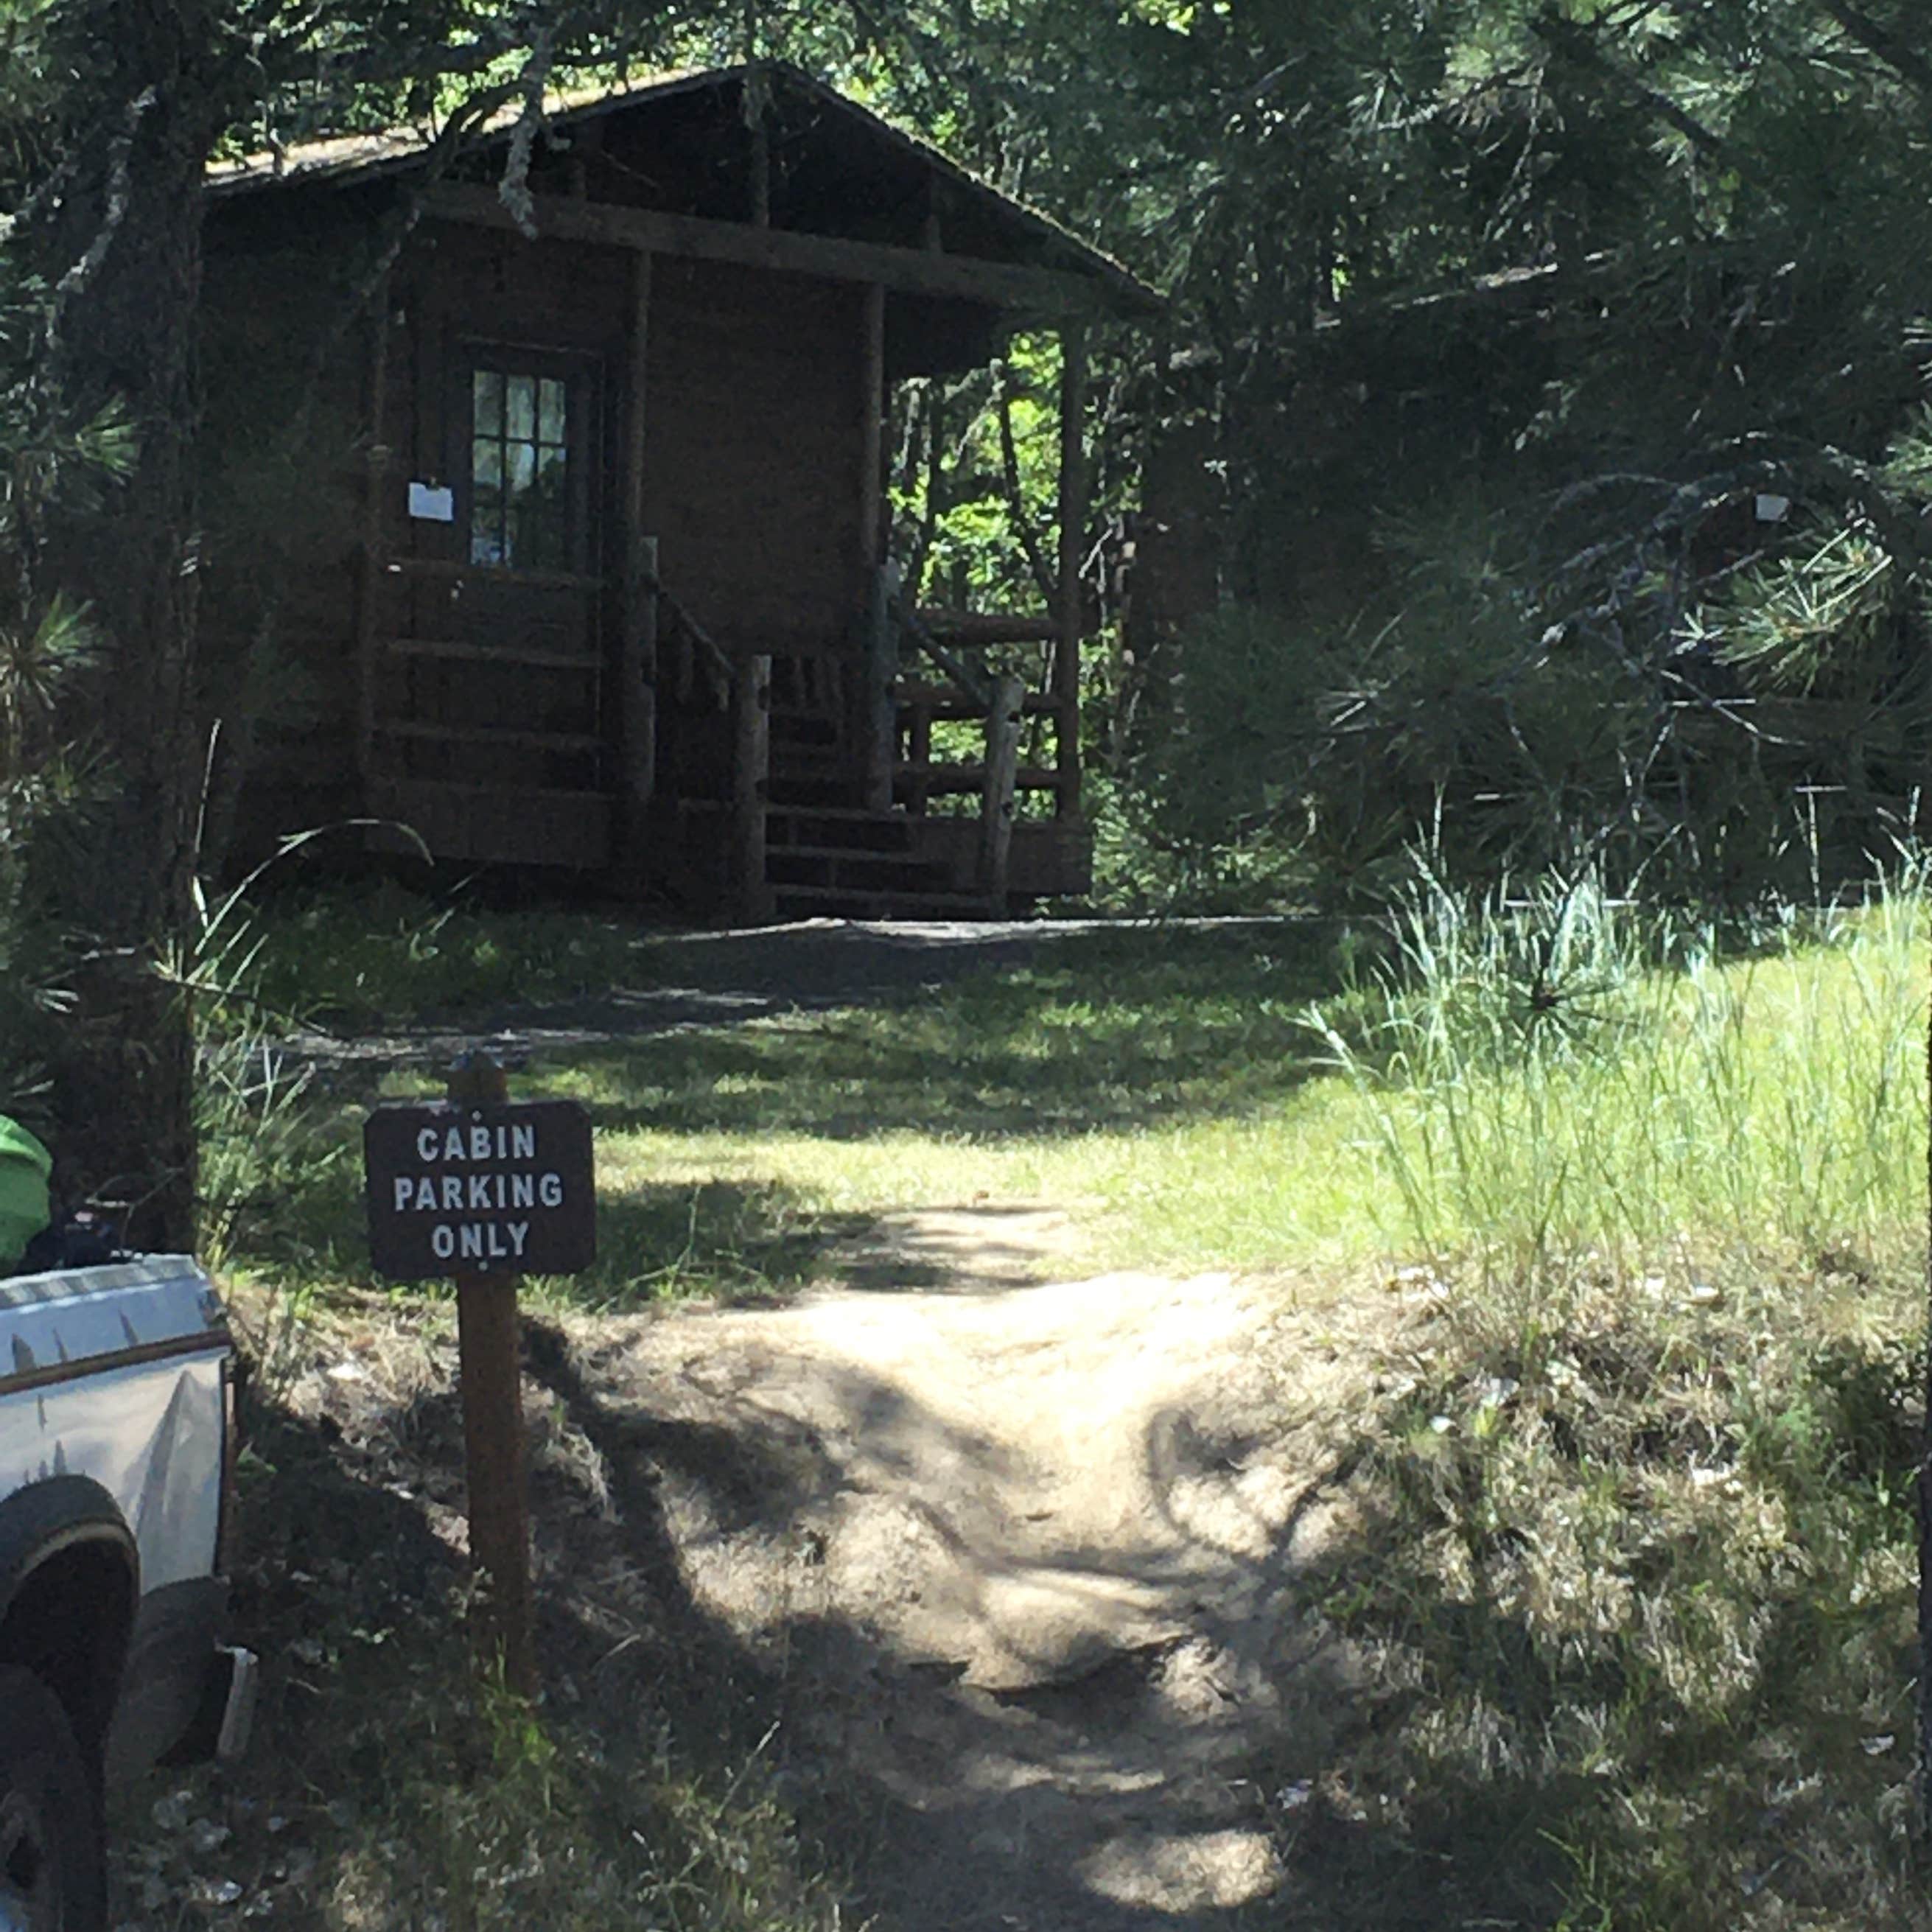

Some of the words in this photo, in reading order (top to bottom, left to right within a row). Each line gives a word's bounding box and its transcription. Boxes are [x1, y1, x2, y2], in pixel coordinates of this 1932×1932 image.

[416, 1126, 535, 1162] CABIN
[394, 1173, 563, 1211] PARKING
[432, 1222, 529, 1258] ONLY
